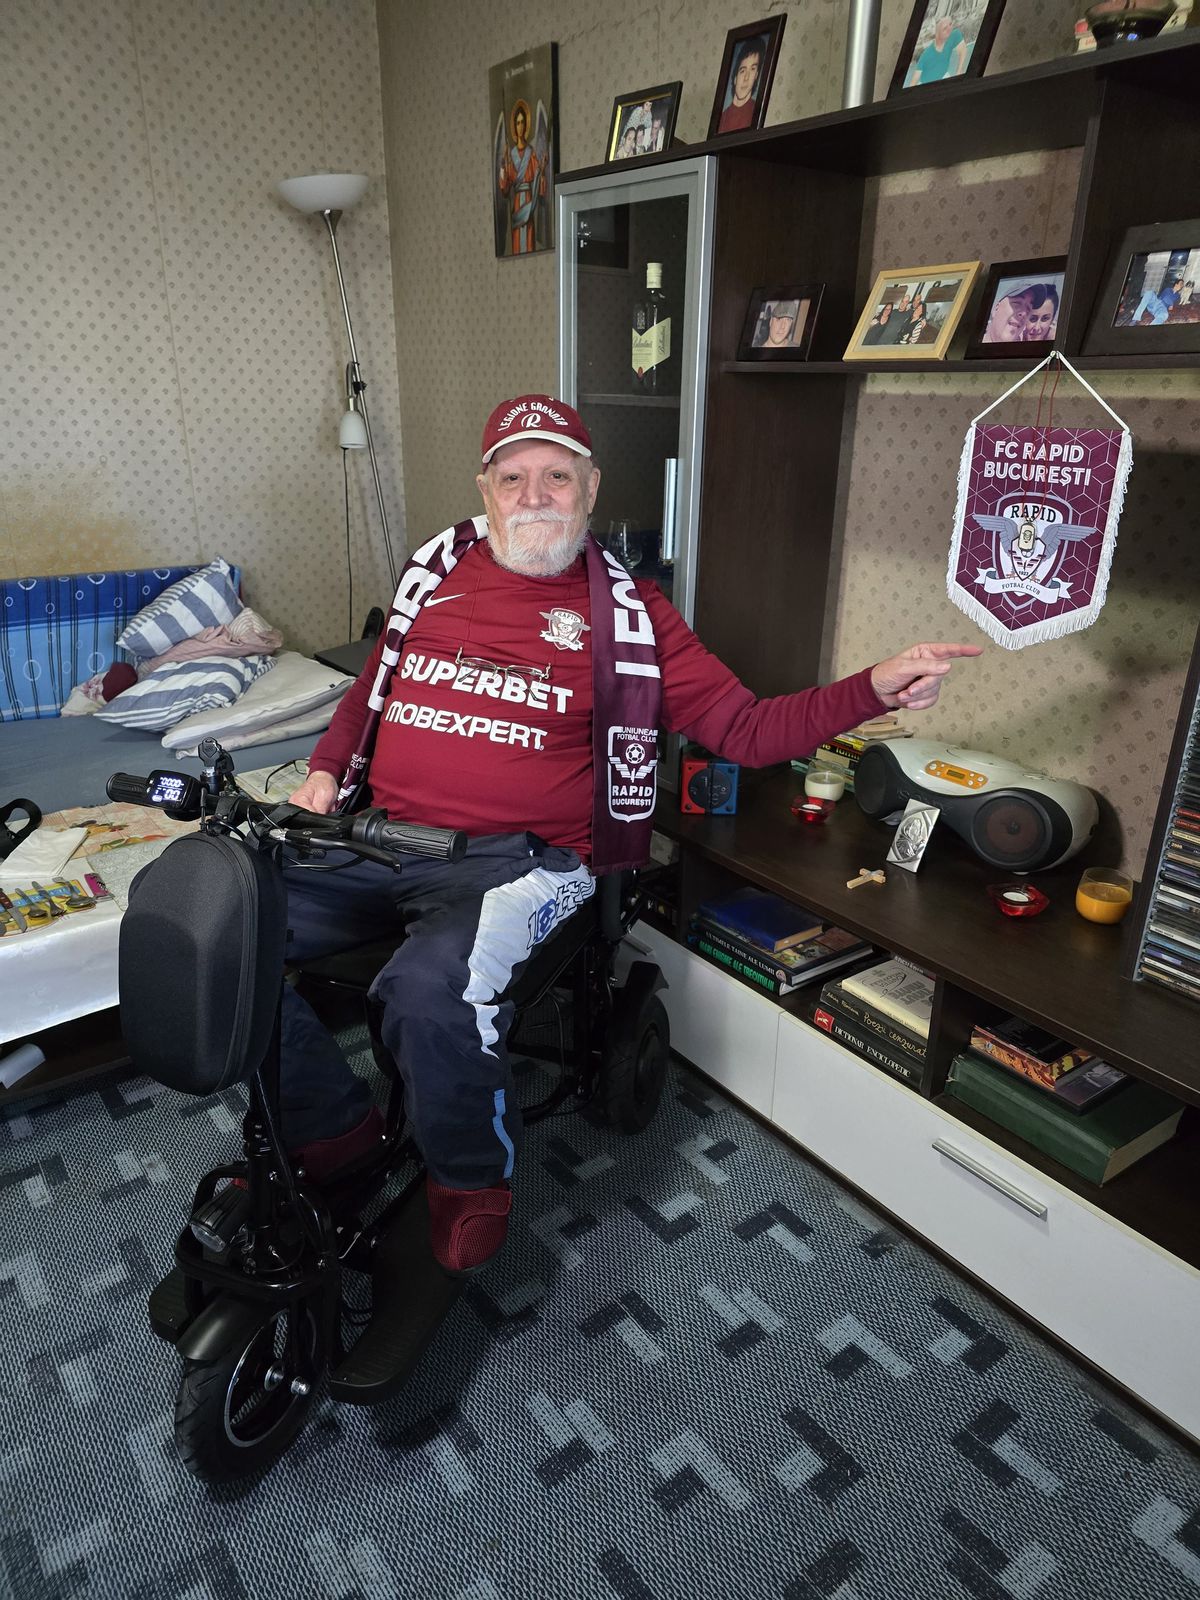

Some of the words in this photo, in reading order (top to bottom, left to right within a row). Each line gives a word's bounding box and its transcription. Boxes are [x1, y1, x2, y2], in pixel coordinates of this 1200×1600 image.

[498, 402, 529, 431] LEGIONE
[994, 440, 1019, 459] FC
[1022, 442, 1085, 463] RAPID
[1010, 505, 1057, 524] RAPID
[1001, 583, 1025, 591] FOTBAL
[1025, 584, 1041, 596] CLUB
[400, 652, 574, 714] SUPERBET
[617, 733, 640, 742] FOTBAL
[612, 785, 653, 797] RAPID
